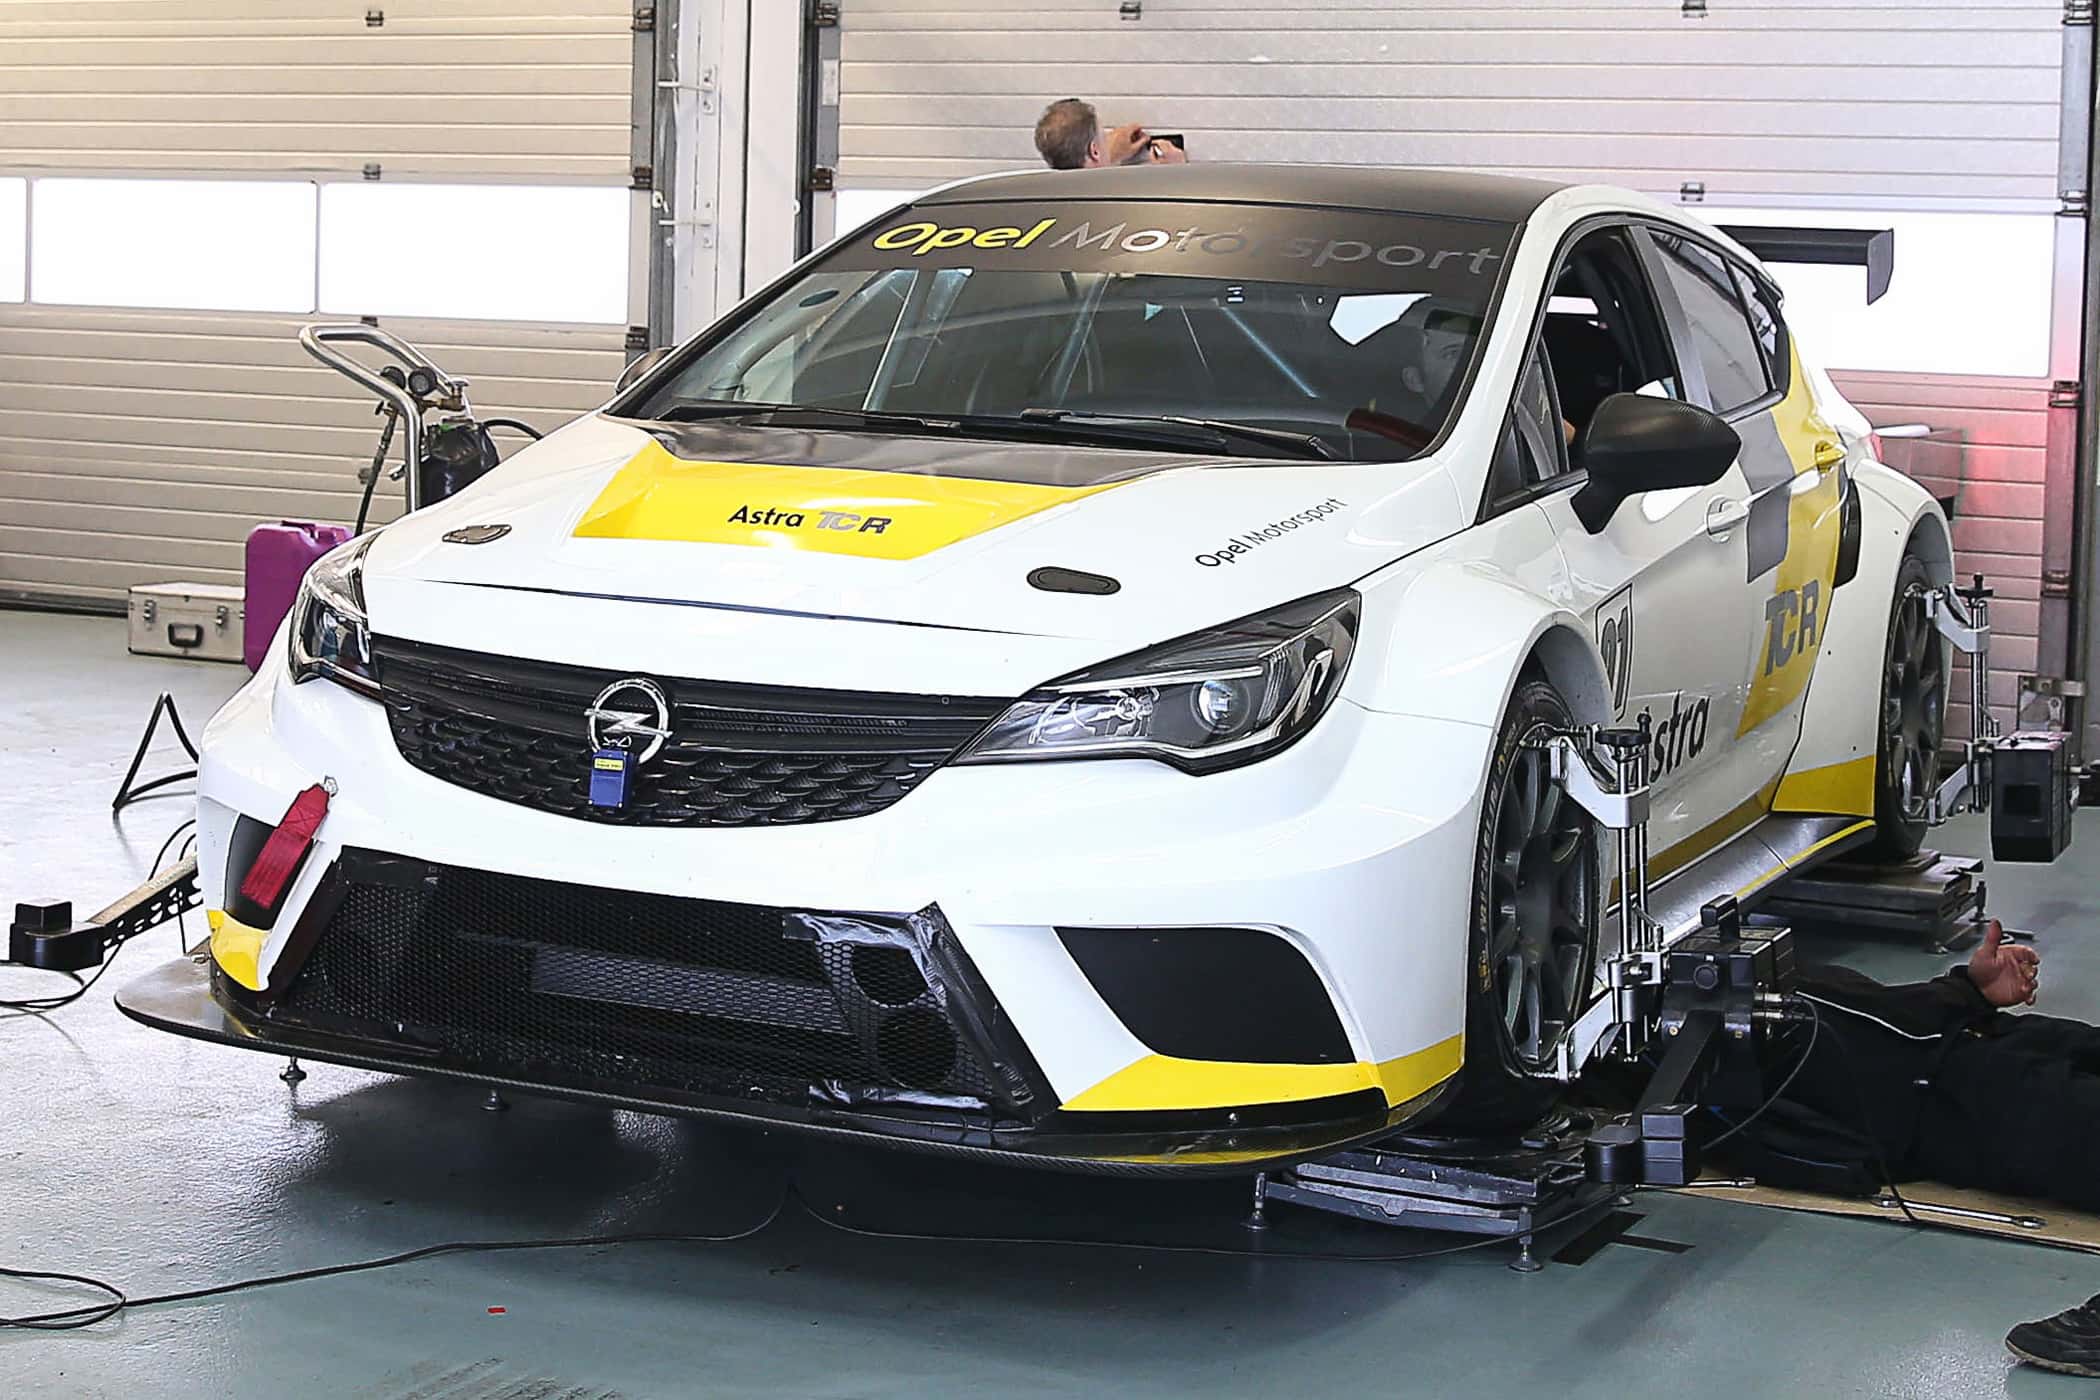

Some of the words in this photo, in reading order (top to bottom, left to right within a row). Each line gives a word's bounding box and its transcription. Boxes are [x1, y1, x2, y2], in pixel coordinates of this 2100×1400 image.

[872, 218, 1057, 257] Opel
[728, 505, 805, 527] Astra
[816, 511, 892, 534] TCR
[1195, 538, 1253, 567] Opel
[1241, 498, 1348, 545] Motorsport
[1764, 579, 1820, 677] TCR
[1649, 690, 1710, 783] stra
